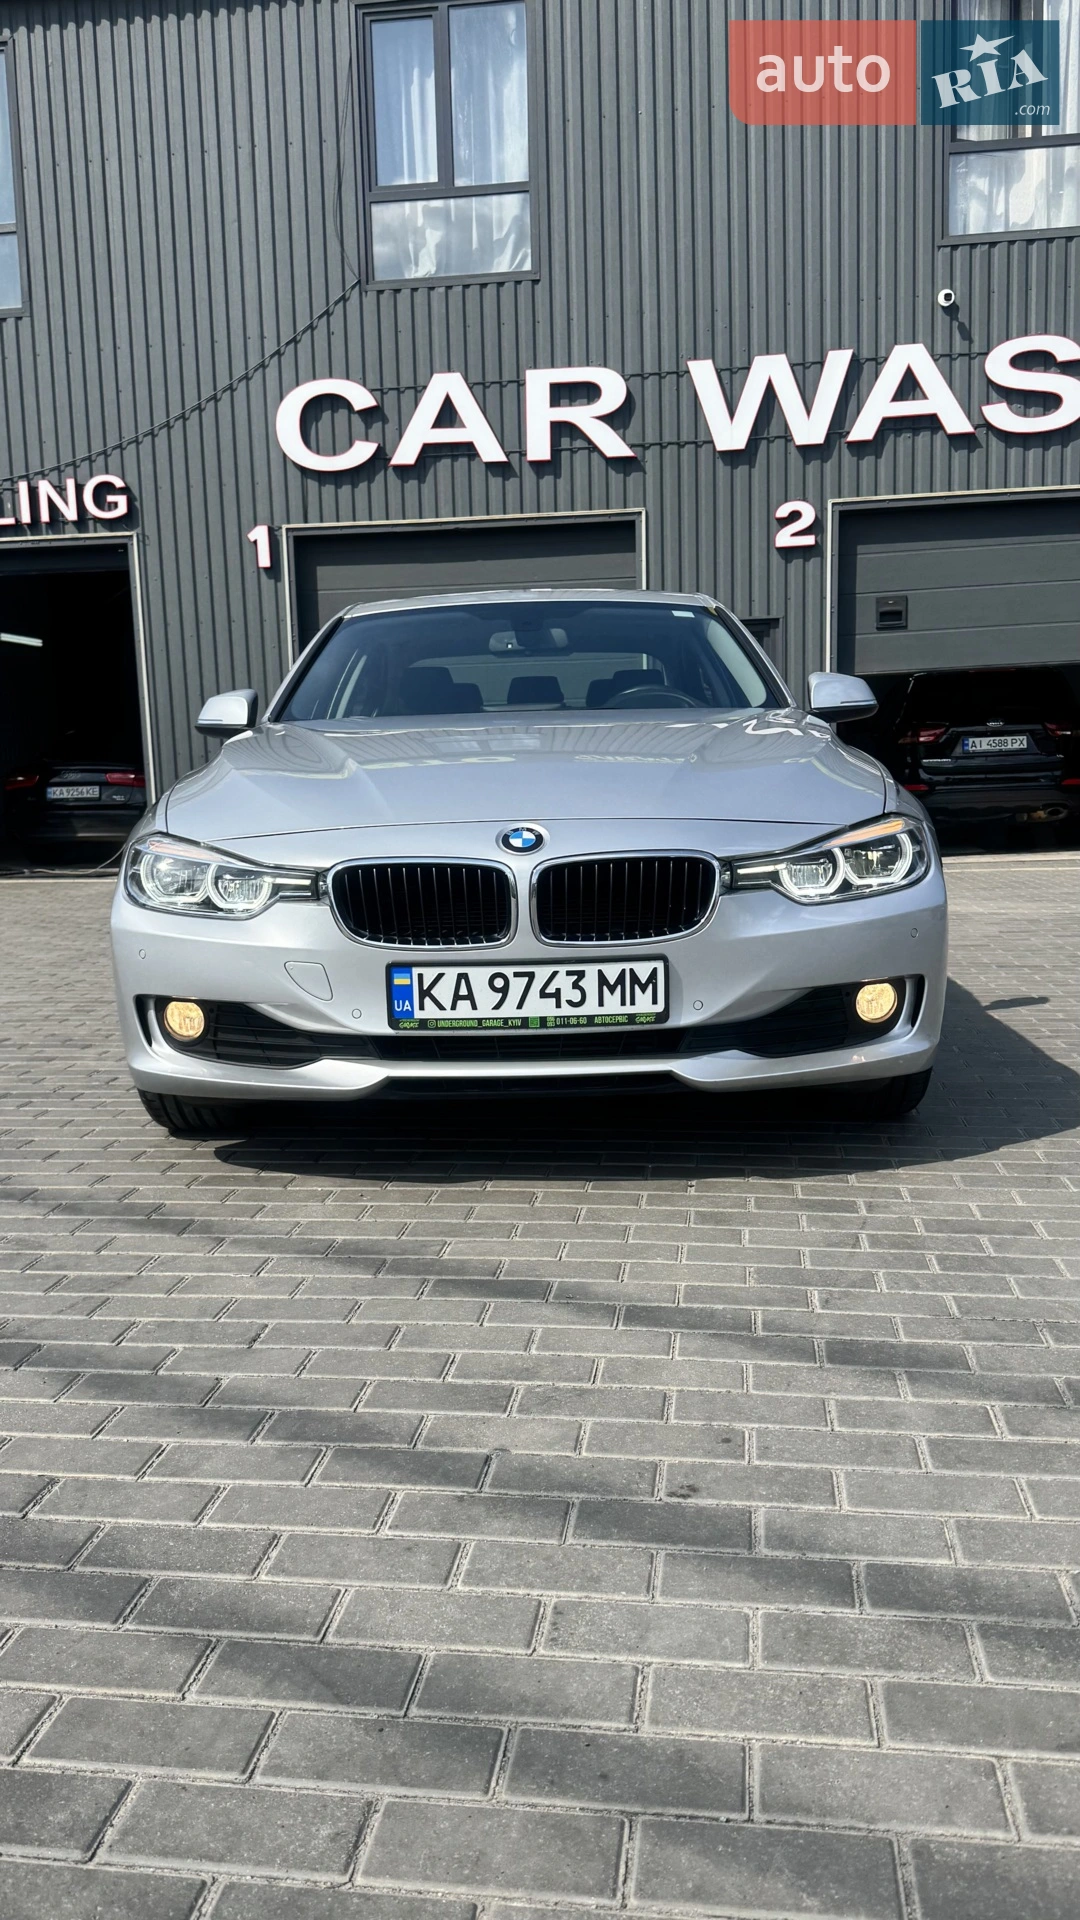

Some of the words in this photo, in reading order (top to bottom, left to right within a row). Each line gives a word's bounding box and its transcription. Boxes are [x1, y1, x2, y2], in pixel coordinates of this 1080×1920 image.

[275, 366, 638, 473] CAR
[774, 500, 817, 549] 2
[246, 525, 272, 569] 1
[986, 738, 1008, 748] 4588
[1011, 737, 1025, 747] PX
[52, 788, 64, 797] KA
[66, 788, 85, 797] 9256
[86, 787, 98, 796] KE
[394, 1000, 412, 1012] UA
[417, 973, 478, 1011] KA
[488, 969, 587, 1010] 9743
[597, 966, 658, 1007] MM
